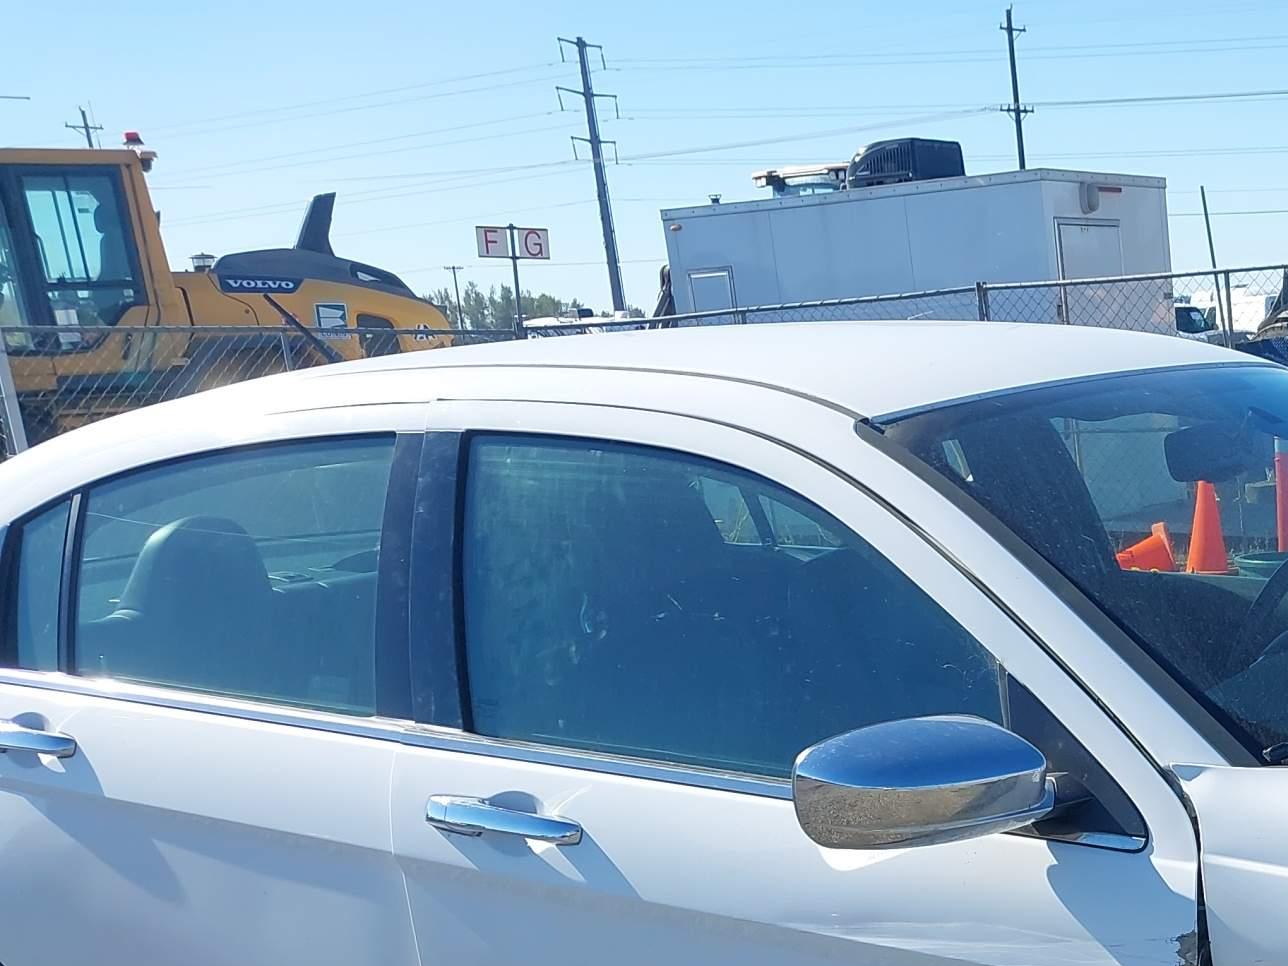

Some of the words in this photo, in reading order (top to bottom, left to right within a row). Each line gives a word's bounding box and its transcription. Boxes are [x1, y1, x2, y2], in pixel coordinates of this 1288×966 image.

[484, 229, 498, 255] F
[524, 230, 543, 257] G
[225, 279, 295, 289] VOLVO
